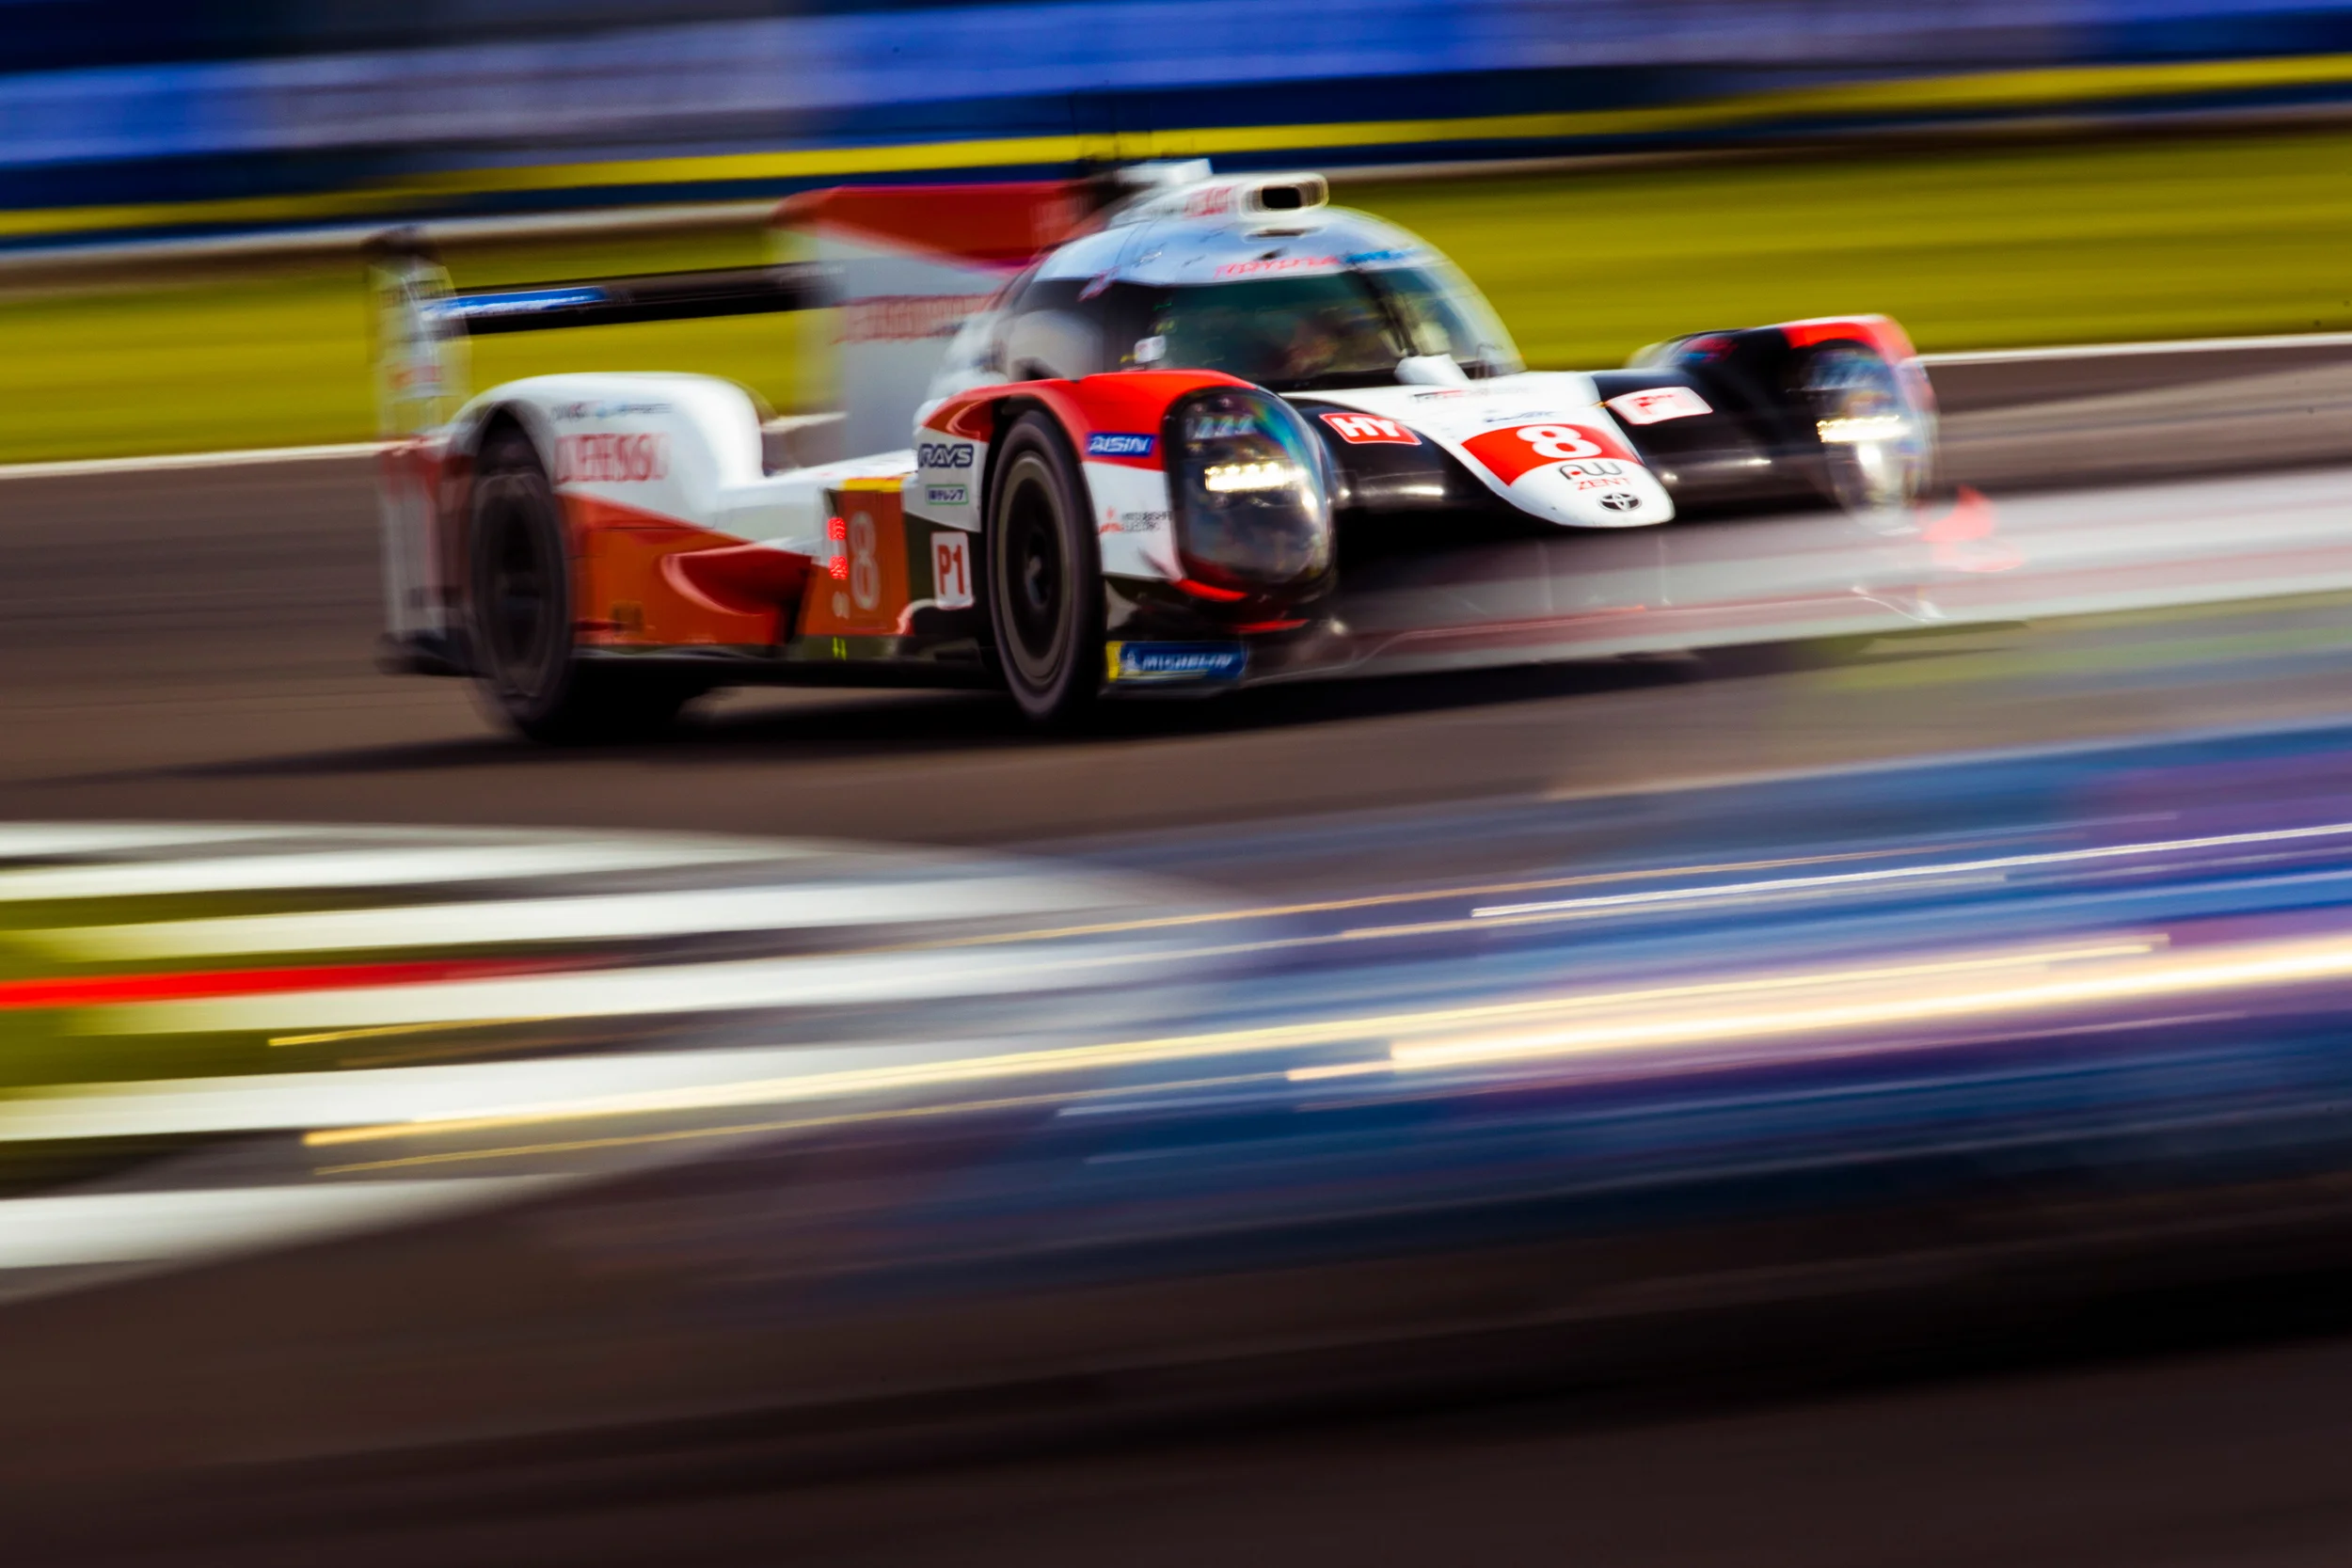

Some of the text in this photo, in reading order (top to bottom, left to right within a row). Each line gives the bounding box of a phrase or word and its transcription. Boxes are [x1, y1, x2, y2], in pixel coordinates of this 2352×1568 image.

[1330, 417, 1401, 437] HY
[1516, 424, 1602, 458] 8
[918, 443, 974, 467] RAYS
[1089, 436, 1151, 452] AISIN
[850, 512, 881, 610] 8
[937, 544, 964, 595] P1
